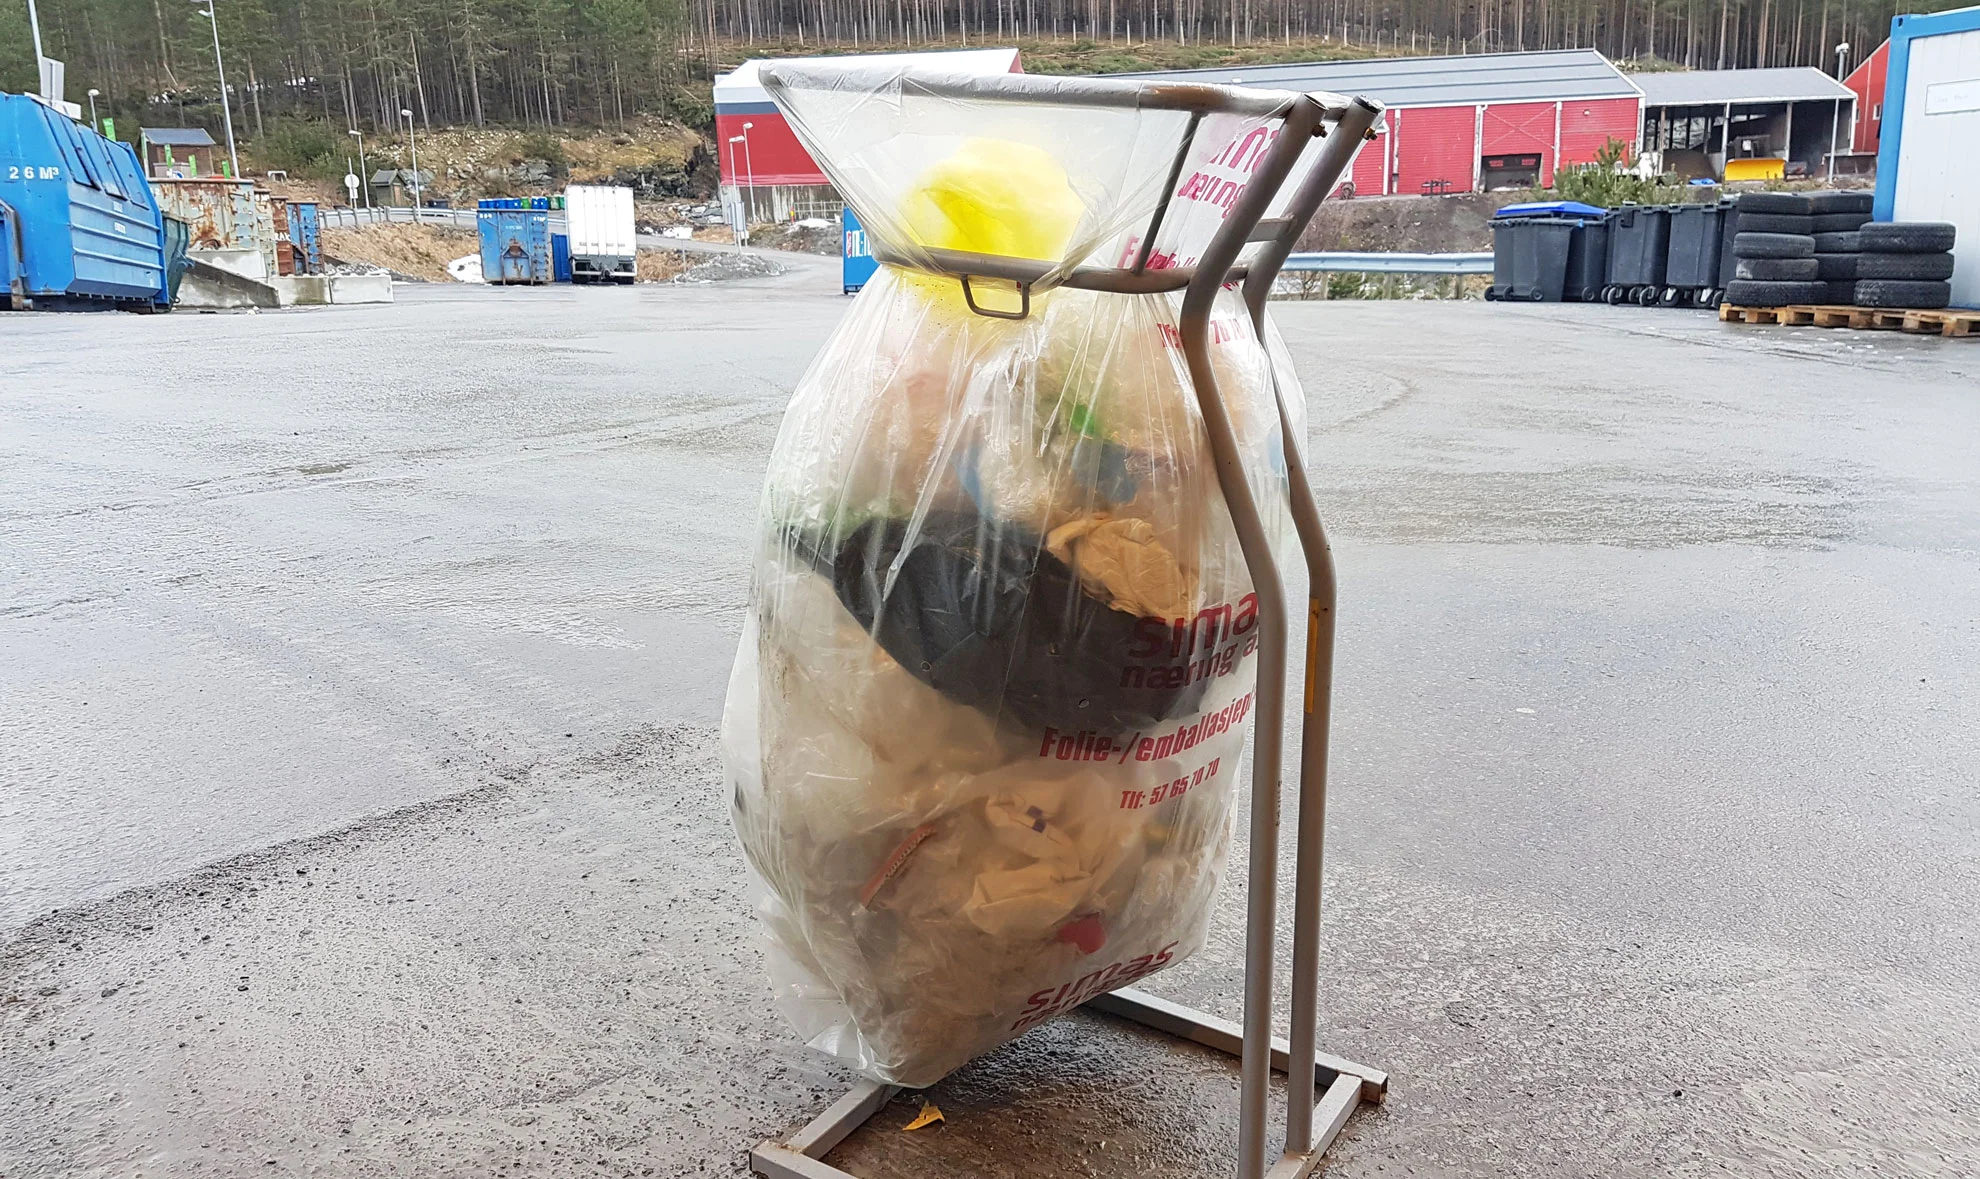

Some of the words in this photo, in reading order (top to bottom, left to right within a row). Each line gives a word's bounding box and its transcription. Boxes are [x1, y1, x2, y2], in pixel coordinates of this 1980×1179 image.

[1127, 592, 1258, 659] sima
[1119, 642, 1239, 689] næring
[1243, 633, 1258, 658] a
[1119, 790, 1146, 810] Tlf:
[1148, 782, 1170, 806] 57
[1169, 775, 1190, 799] 65
[1188, 766, 1205, 790] 70
[1204, 757, 1221, 781] 70
[1020, 940, 1180, 1015] simas
